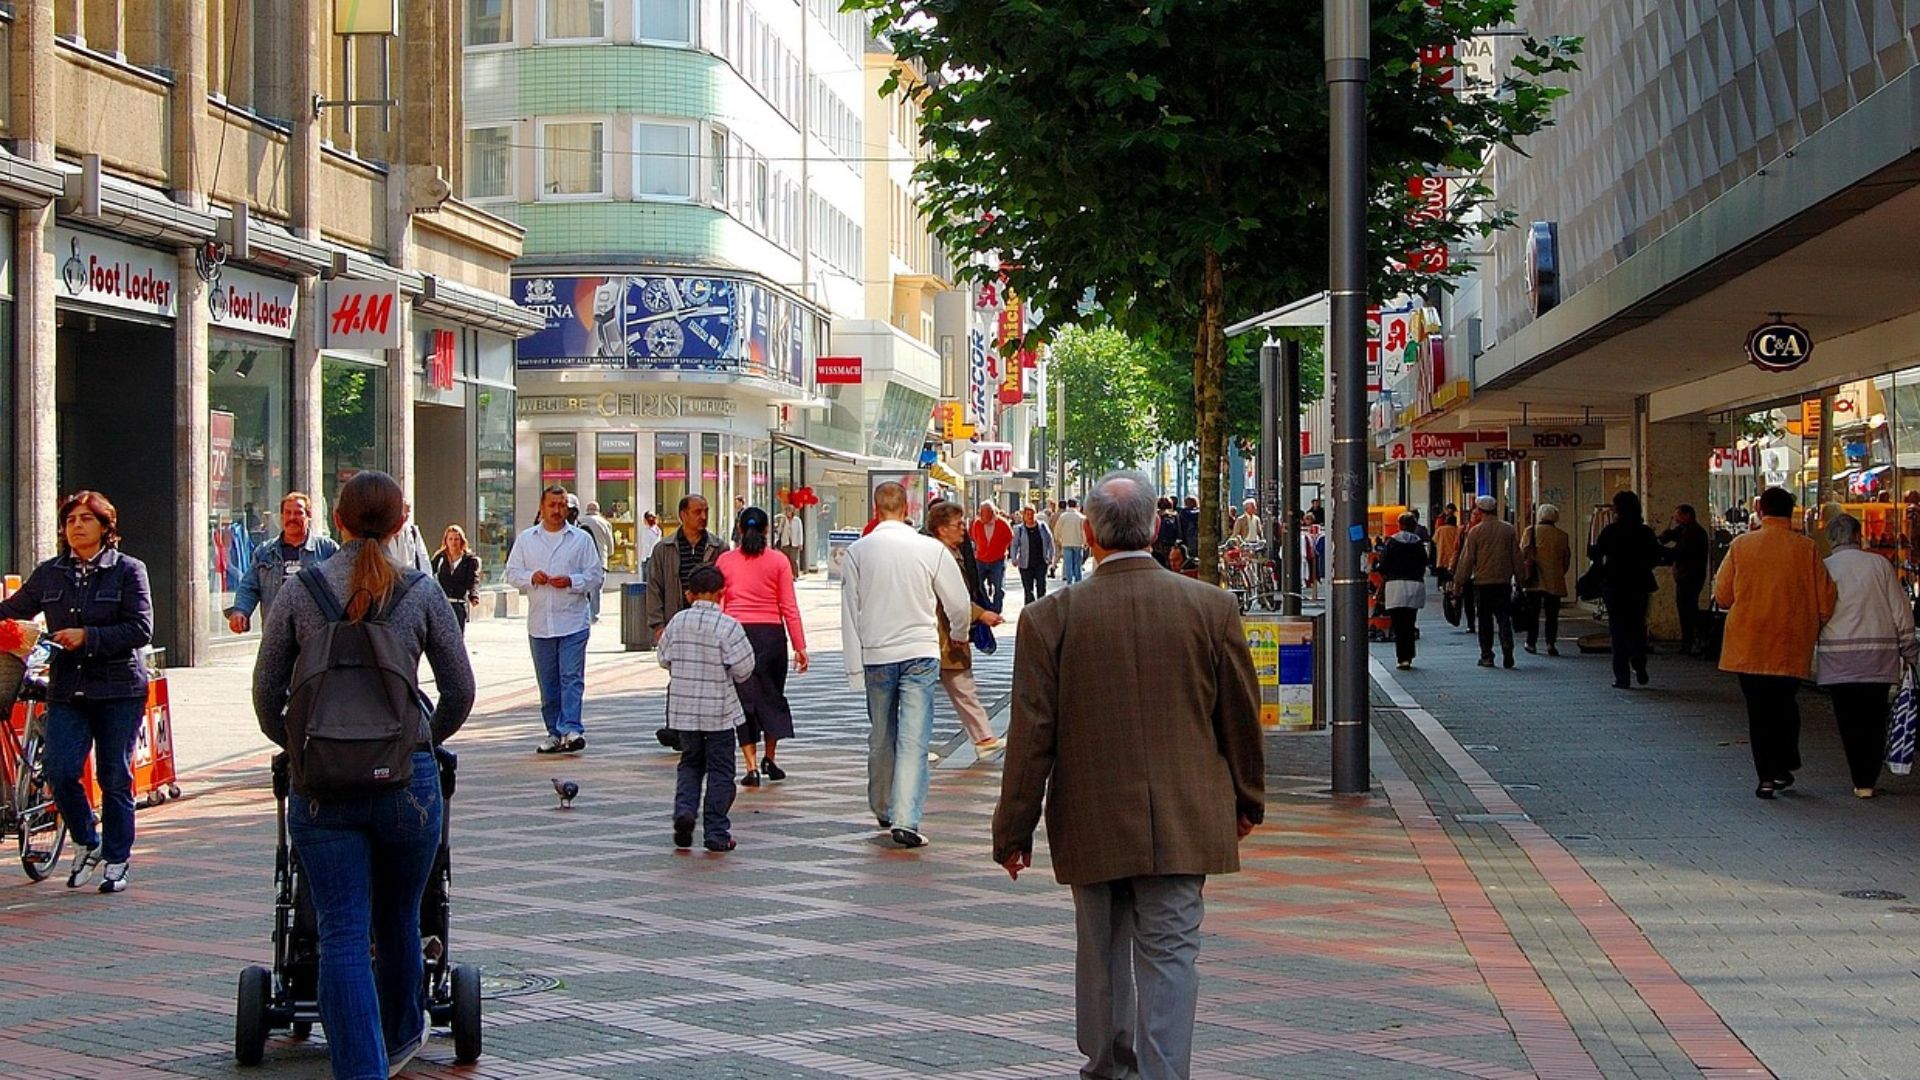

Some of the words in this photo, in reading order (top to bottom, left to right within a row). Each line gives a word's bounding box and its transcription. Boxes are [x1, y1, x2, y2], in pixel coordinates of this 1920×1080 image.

[89, 255, 120, 296] Foot
[125, 263, 171, 306] Locker
[228, 286, 253, 322] Foot
[256, 292, 292, 330] Locker
[331, 293, 393, 335] H&M
[1759, 334, 1803, 356] C&A
[818, 365, 861, 376] WISSMACH
[598, 391, 684, 417] CHRIST
[1532, 433, 1582, 447] RENO
[1485, 449, 1527, 460] RENO
